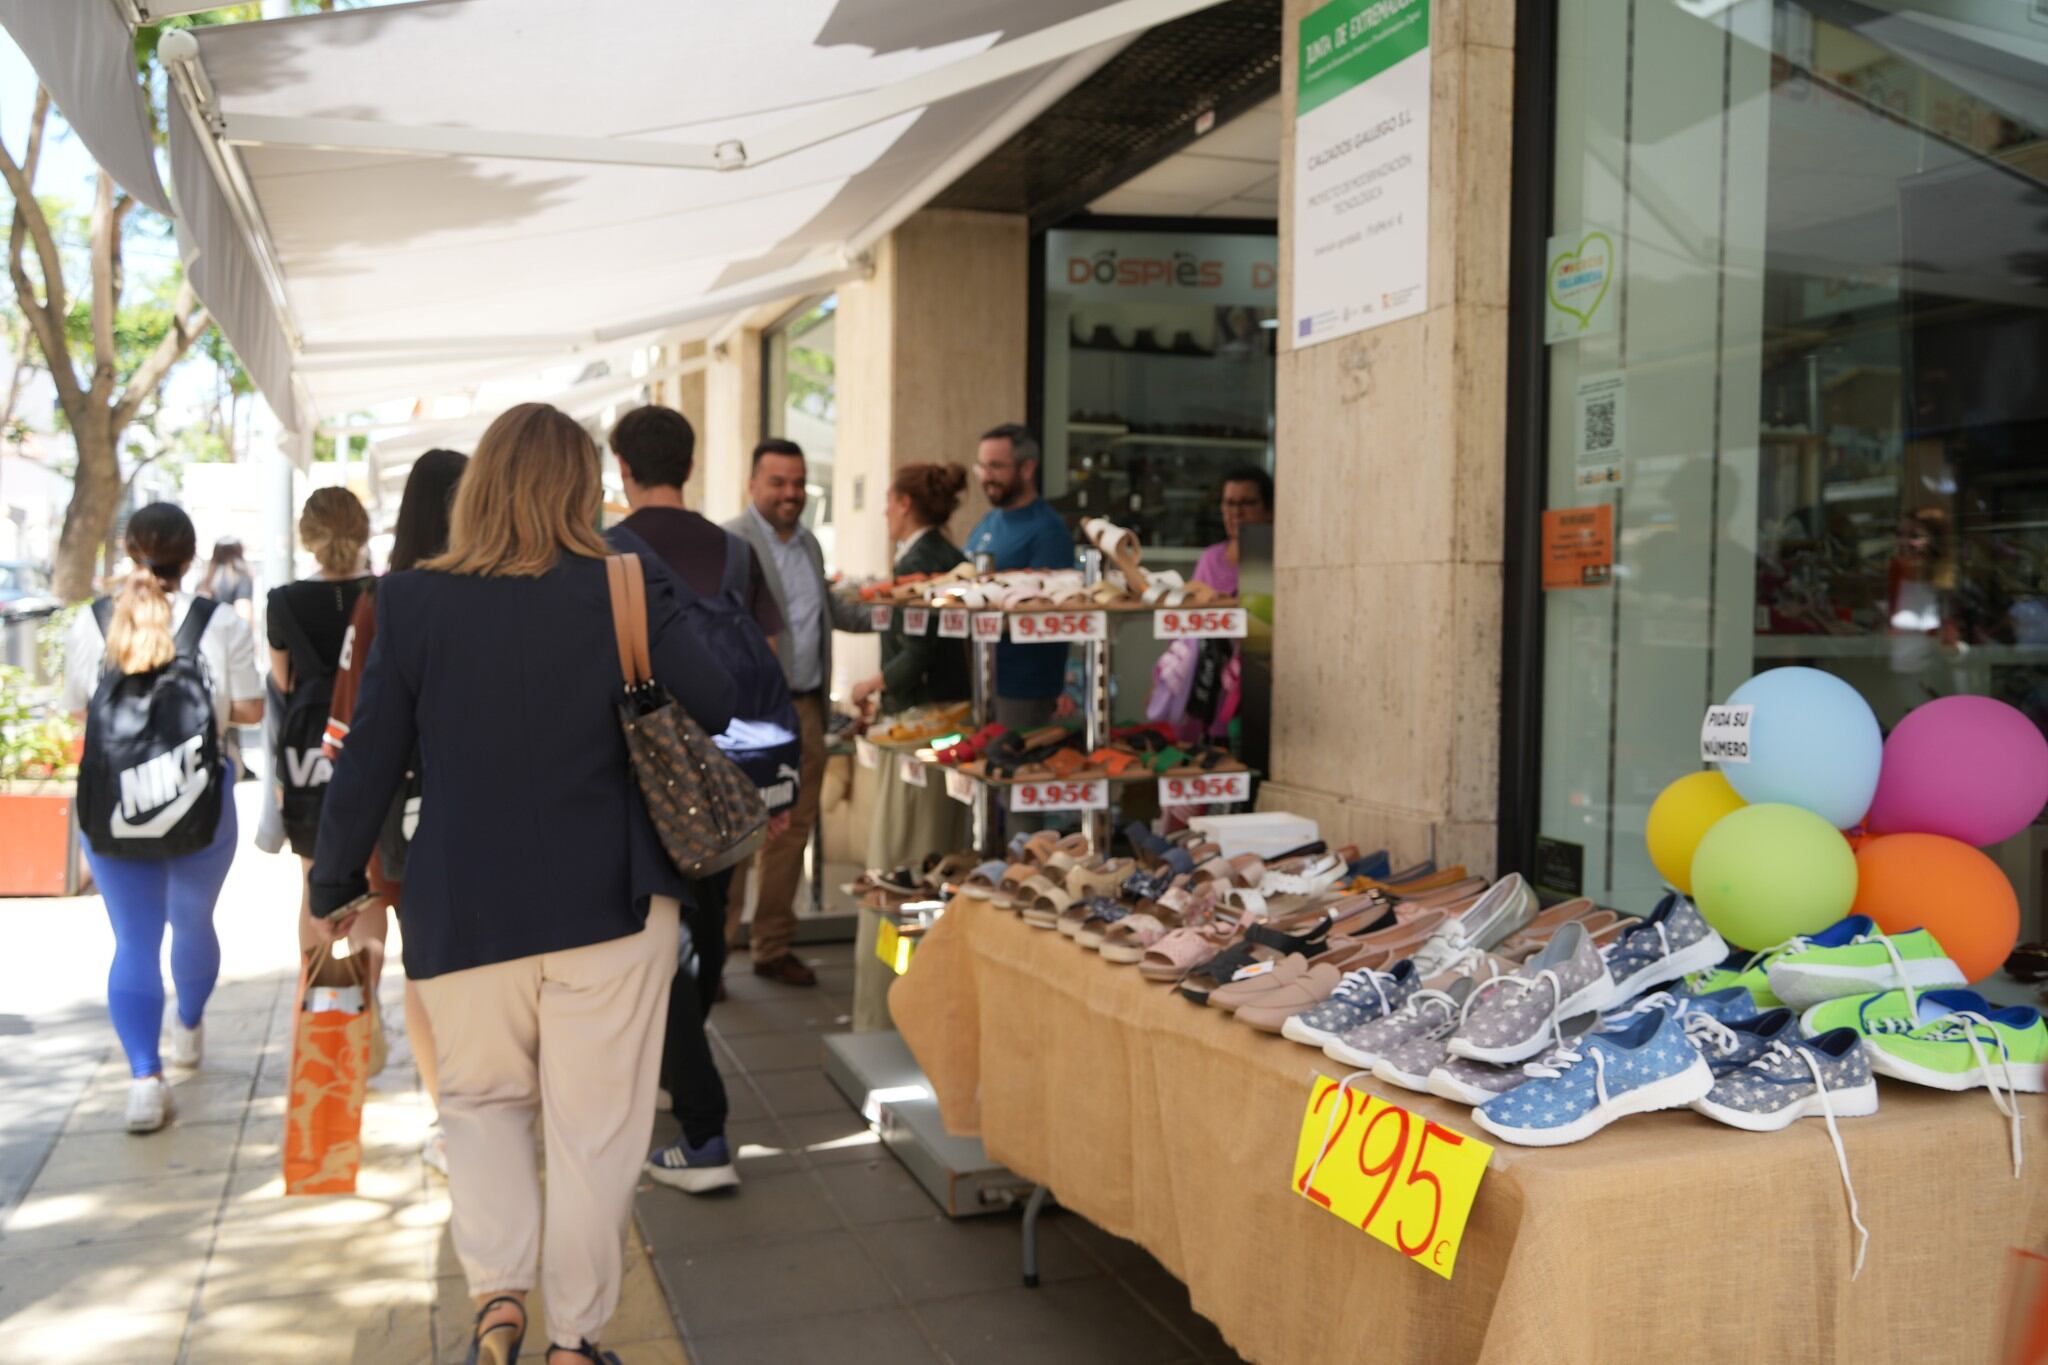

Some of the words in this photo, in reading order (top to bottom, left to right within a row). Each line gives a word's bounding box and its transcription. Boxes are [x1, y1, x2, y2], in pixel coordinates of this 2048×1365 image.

[1018, 614, 1097, 637] 9,95€
[1163, 612, 1238, 635] 9,95€
[1708, 711, 1731, 727] PIDA
[1733, 711, 1749, 727] SU
[120, 734, 204, 820] NIKE
[1020, 782, 1098, 807] 9,95€
[1168, 777, 1240, 800] 9,95€
